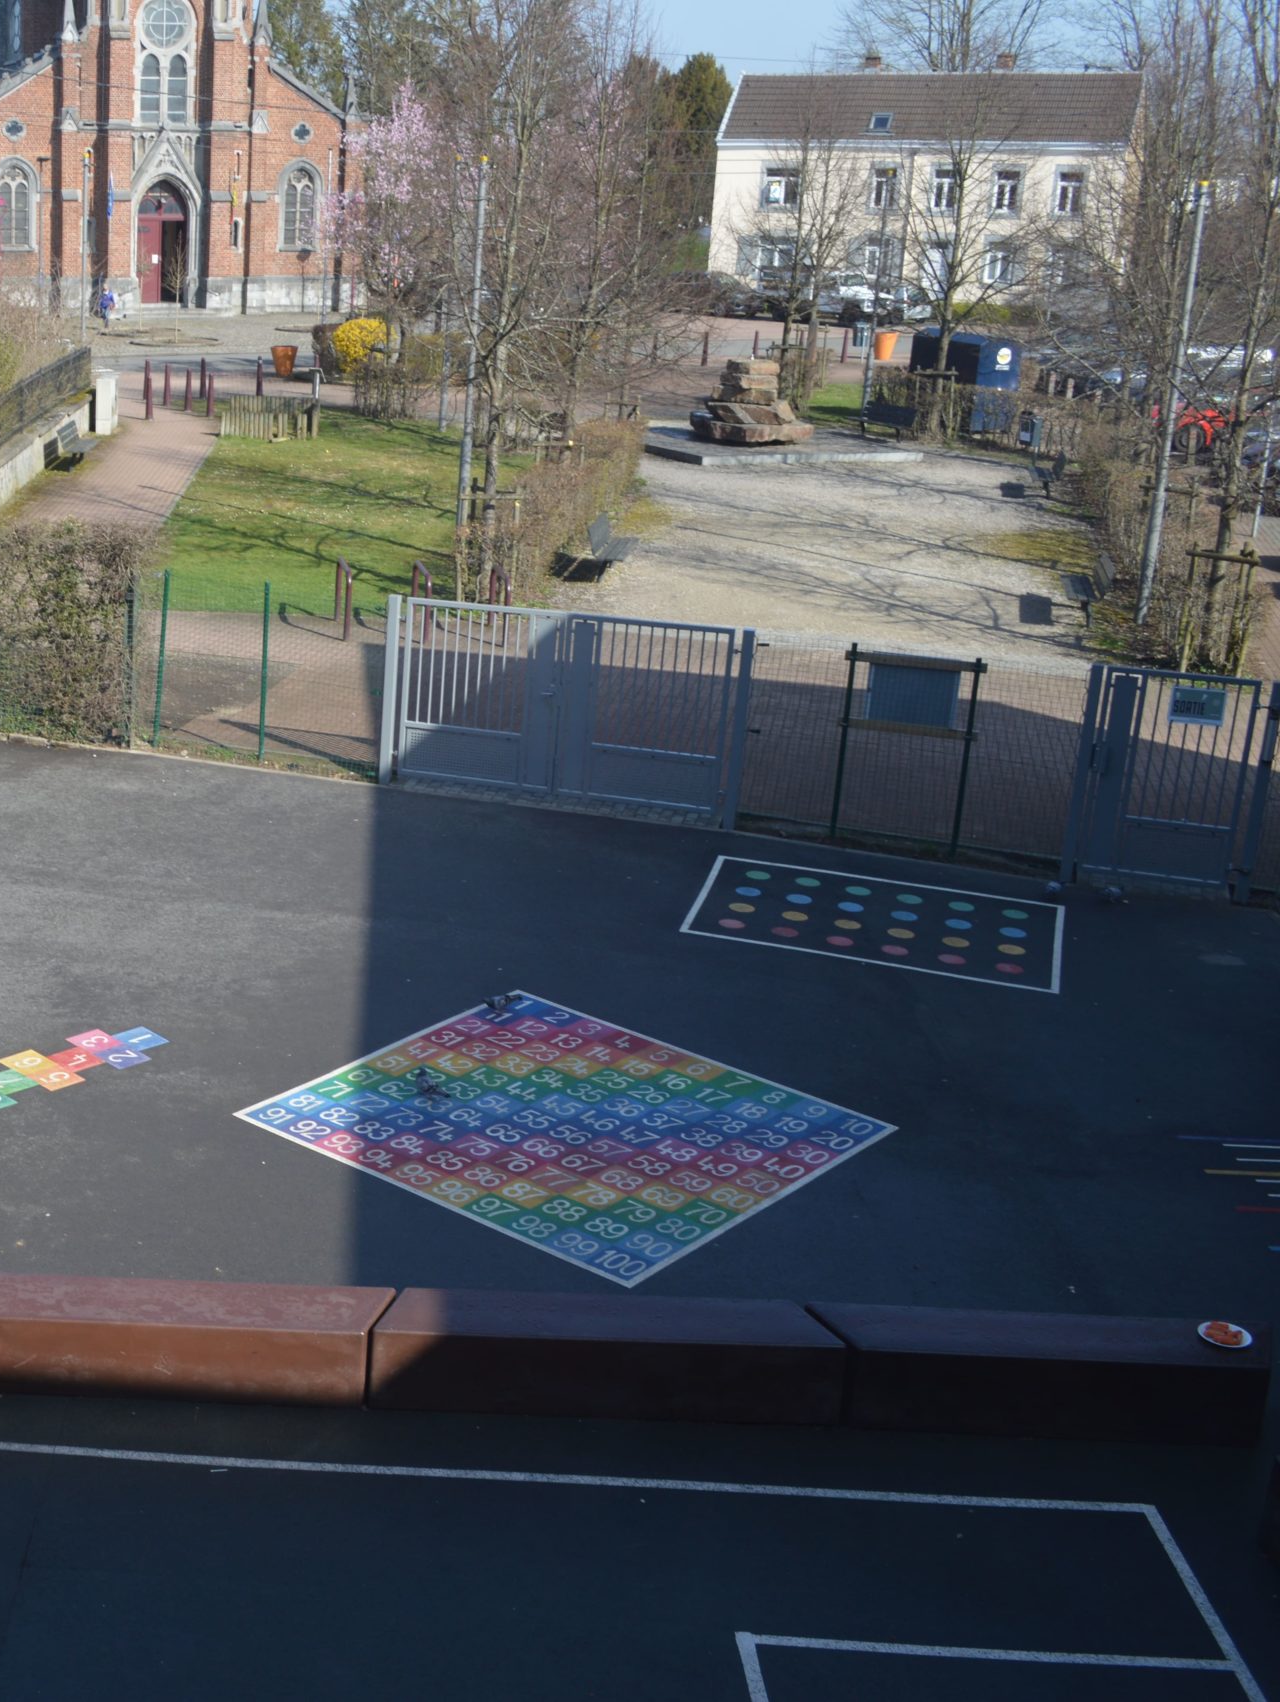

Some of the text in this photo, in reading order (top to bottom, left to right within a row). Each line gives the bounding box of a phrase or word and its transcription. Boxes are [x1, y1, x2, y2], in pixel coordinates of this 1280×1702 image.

[1173, 700, 1207, 716] SORTIE
[40, 1072, 70, 1084] 5
[68, 1054, 87, 1066] 4
[82, 1036, 138, 1062] 2 3
[128, 1034, 152, 1044] 1
[430, 1030, 804, 1178] 31 32 33 34 35 36 37 38 39 40
[454, 1019, 829, 1164] 21 22 23 24 25 26 27 28 29 30
[514, 1000, 873, 1135] 1 2 3 4 5 6 7 8 9 10
[516, 1020, 547, 1036] 12
[549, 1033, 582, 1048] 13
[584, 1046, 610, 1061] 14
[620, 1060, 655, 1075] 15
[659, 1073, 691, 1089] 16
[695, 1088, 732, 1102] 17
[734, 1102, 767, 1118] 18
[773, 1116, 808, 1132] 19
[809, 1130, 854, 1149] 20
[288, 1094, 672, 1257] 81 82 83 84 85 86 87 88 89 90
[318, 1080, 701, 1240] 71 72 73 74 75 76 77 78 79 80
[346, 1068, 382, 1084] 61
[377, 1080, 417, 1100] 62
[448, 1108, 482, 1127] 64
[484, 1123, 528, 1142] 65
[522, 1138, 564, 1157] 66
[560, 1153, 606, 1171] 67
[600, 1169, 643, 1190] 68
[640, 1185, 684, 1207] 69
[684, 1201, 727, 1224] 70
[376, 1055, 410, 1071] 51
[441, 1080, 481, 1099] 53
[475, 1094, 510, 1113] 54
[512, 1109, 557, 1128] 55
[548, 1124, 592, 1144] 56
[586, 1139, 632, 1156] 57
[627, 1154, 671, 1175] 58
[668, 1170, 712, 1191] 59
[710, 1187, 754, 1208] 60
[407, 1042, 779, 1193] 41 42 43 44 45 46 47 48 49 50
[258, 1107, 646, 1275] 91 92 93 94 95 96 97 98 99 100
